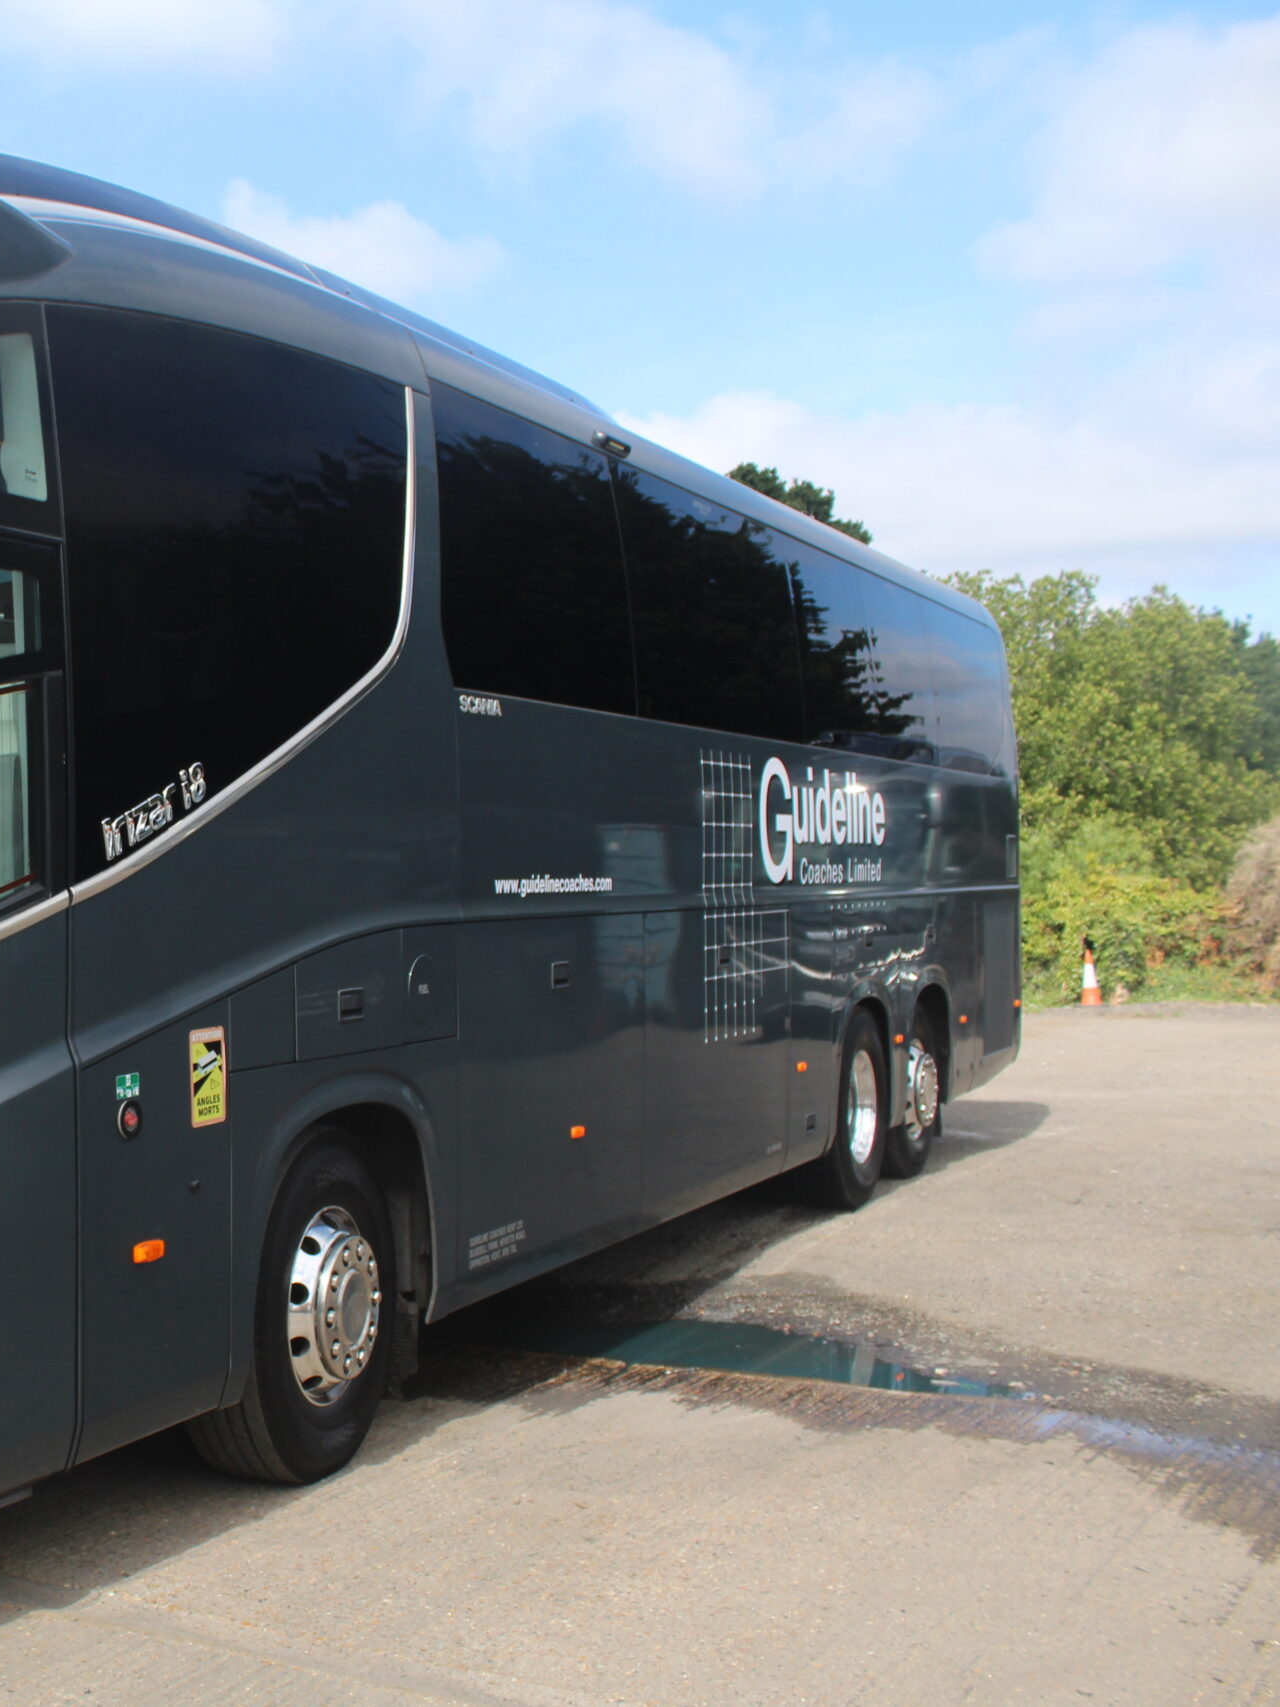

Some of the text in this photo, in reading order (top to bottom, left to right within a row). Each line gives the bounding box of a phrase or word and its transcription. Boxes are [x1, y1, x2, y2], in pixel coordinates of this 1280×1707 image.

[459, 694, 502, 716] SCANIA
[759, 756, 886, 886] Guideline
[800, 857, 882, 885] Coaches Limited
[494, 873, 613, 898] www.guidelinecoaches.com
[197, 1094, 221, 1107] ANGLES
[198, 1104, 220, 1117] MORTS
